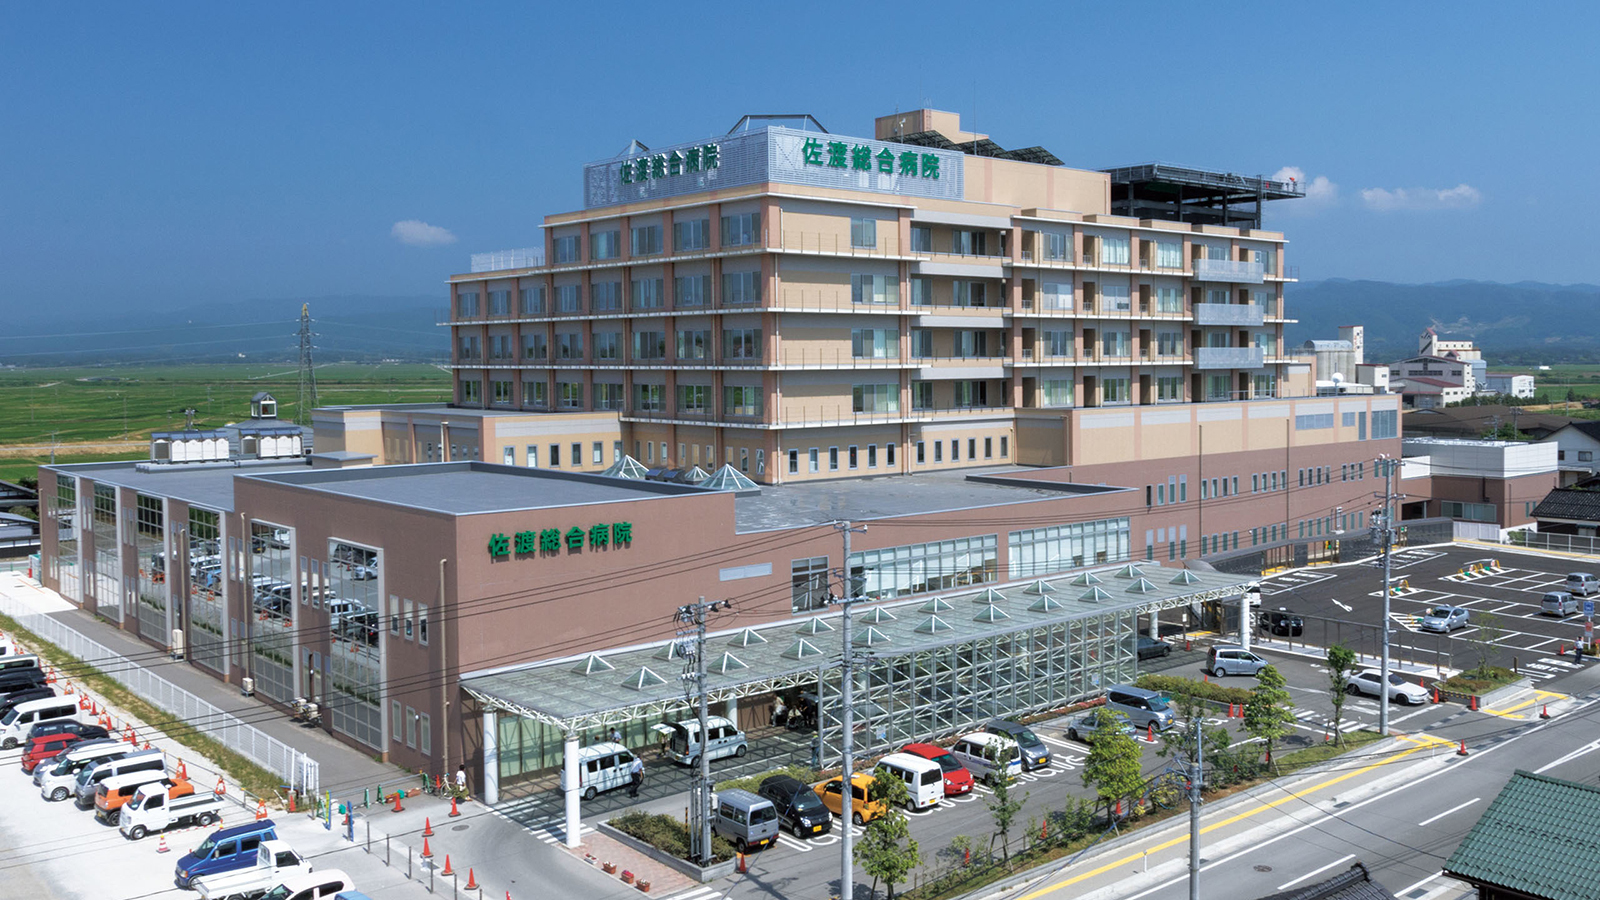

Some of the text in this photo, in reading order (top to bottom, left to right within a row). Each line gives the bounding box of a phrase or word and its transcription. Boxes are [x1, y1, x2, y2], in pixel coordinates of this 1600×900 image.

[620, 142, 719, 185] 佐渡総合病院
[802, 137, 940, 179] 佐渡総合病院
[488, 521, 633, 557] 佐渡総合病院
